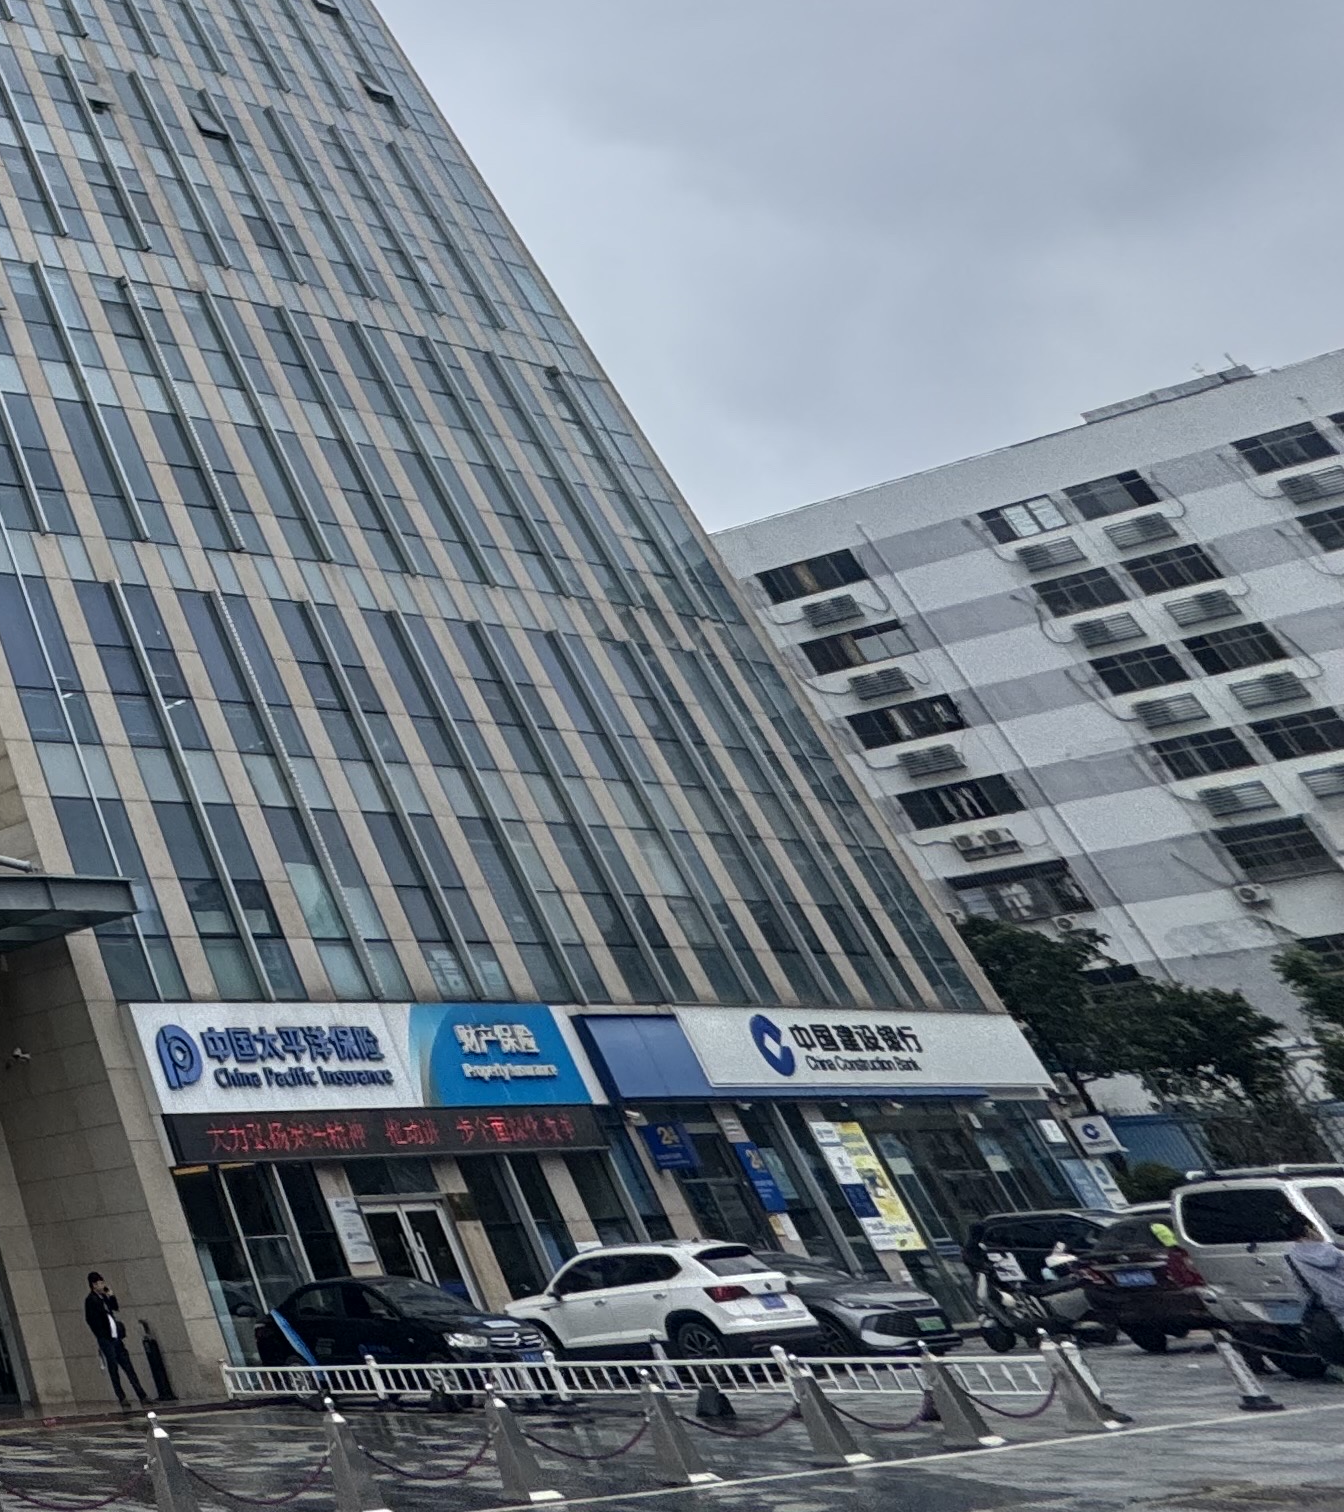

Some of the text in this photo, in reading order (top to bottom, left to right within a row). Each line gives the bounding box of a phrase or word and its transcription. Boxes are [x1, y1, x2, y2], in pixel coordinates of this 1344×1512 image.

[200, 1026, 385, 1065] 中国太平洋保险
[453, 1024, 541, 1055] 财产保险
[785, 1024, 924, 1054] 中国建设银行
[213, 1066, 394, 1089] China Pacific Insurance
[805, 1055, 923, 1072] China Construction Bank
